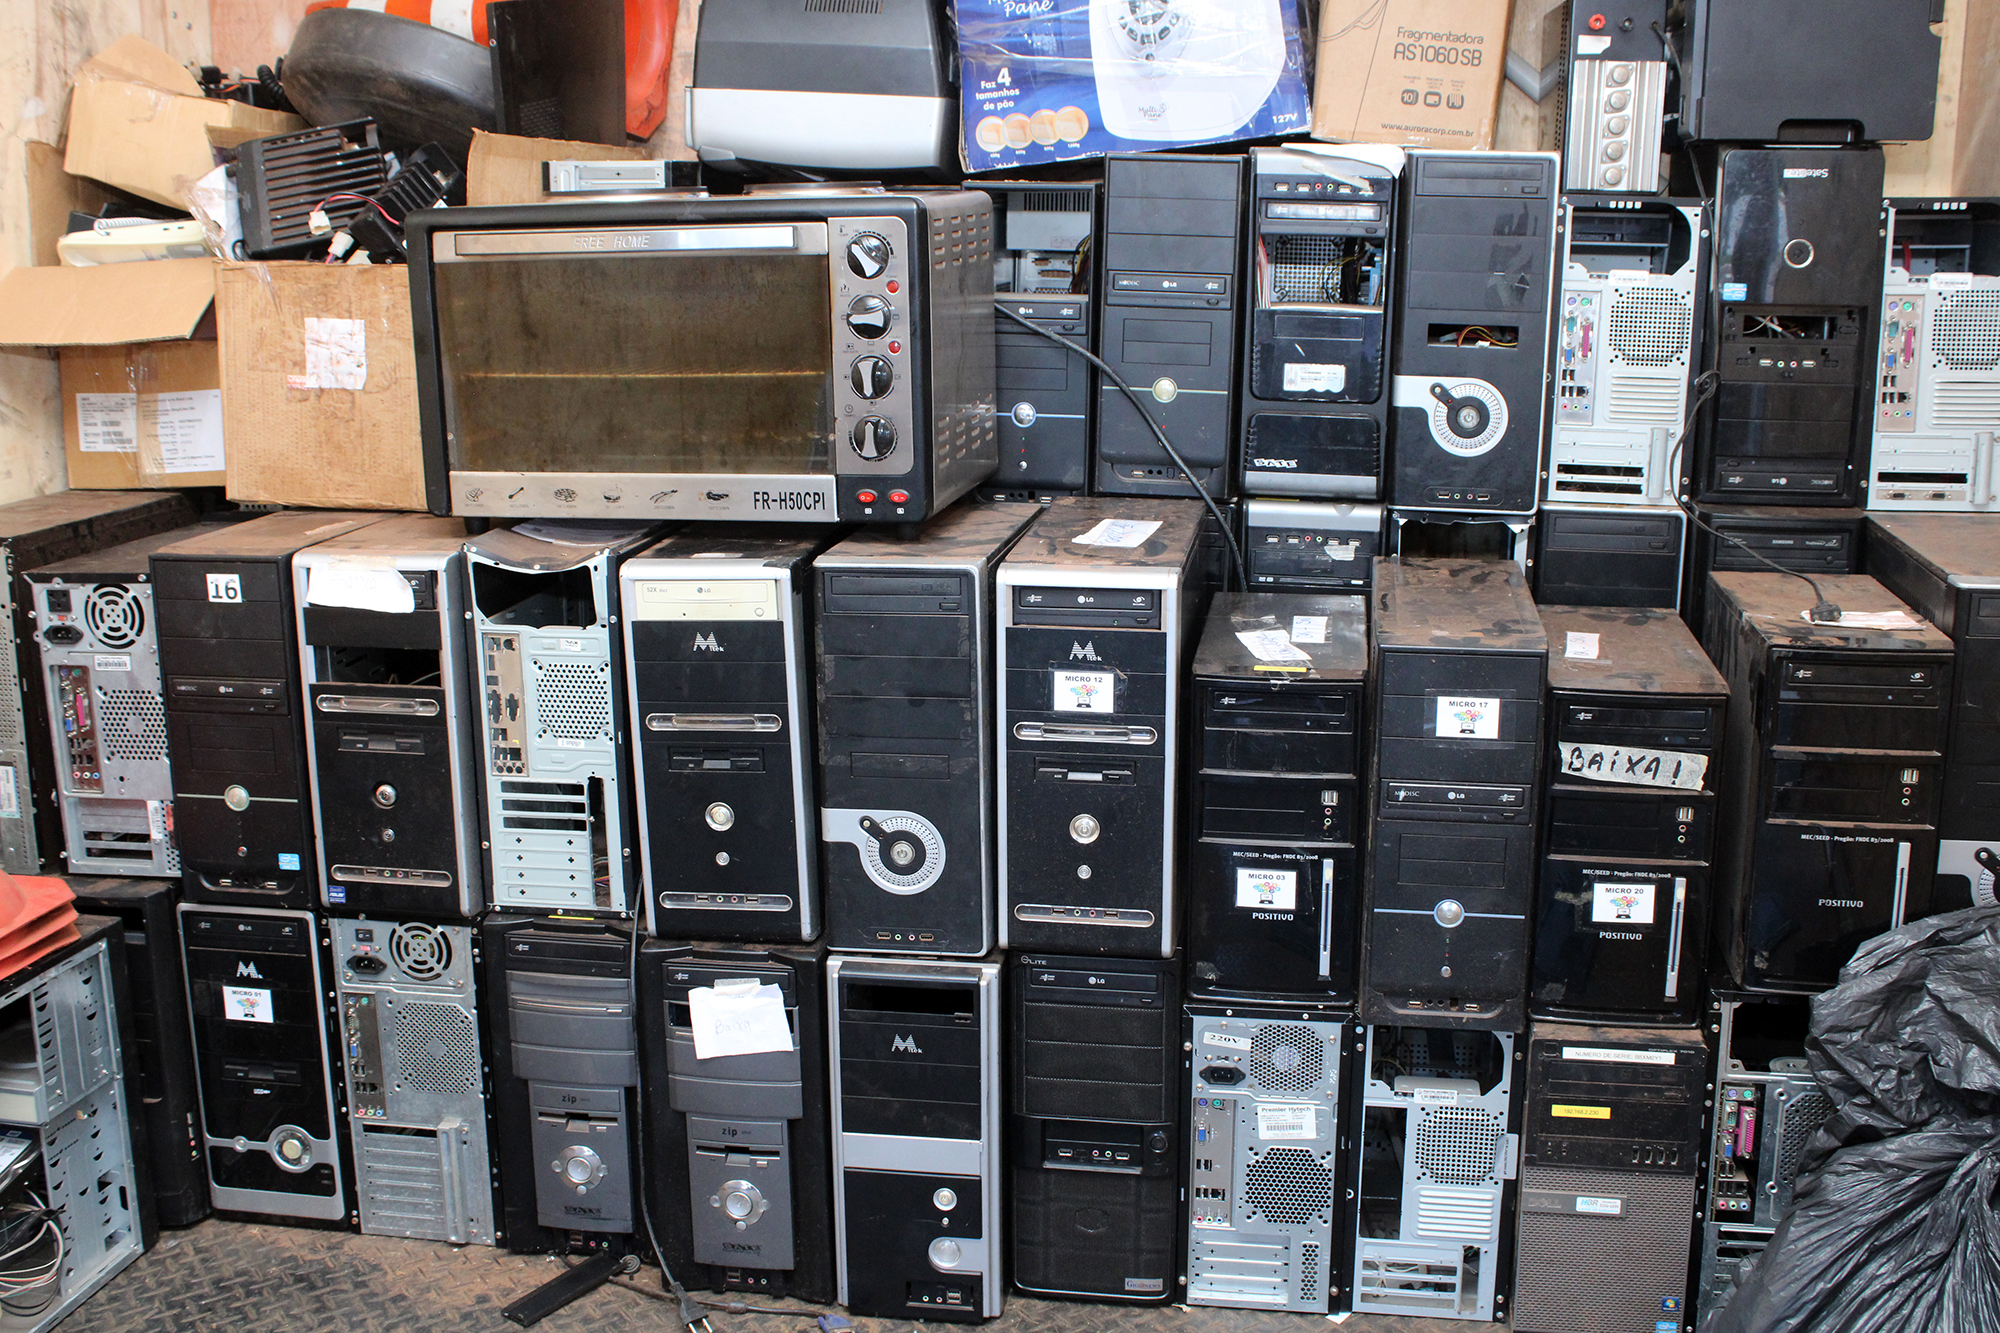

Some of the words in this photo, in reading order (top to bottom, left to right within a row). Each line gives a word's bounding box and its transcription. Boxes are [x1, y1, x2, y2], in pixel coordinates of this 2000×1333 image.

[1396, 26, 1484, 44] Fragmentadora
[981, 80, 996, 89] Faz
[997, 67, 1012, 86] 4
[976, 88, 1020, 100] tamanhos
[983, 101, 995, 110] de
[997, 100, 1014, 111] pão
[1272, 113, 1298, 124] 127V
[1381, 123, 1475, 137] www.auroracorp.com.br
[1790, 168, 1829, 179] Satellite
[573, 236, 605, 249] FREE
[613, 234, 650, 248] HOME
[1253, 458, 1297, 469] SATE
[753, 491, 826, 511] FR-H50CPI
[210, 578, 238, 600] 16
[1065, 675, 1091, 683] MICRO
[1818, 899, 1864, 908] POSITIVO
[1252, 912, 1294, 921] POSITIVO
[1599, 932, 1643, 941] POSITIVO
[1209, 1034, 1241, 1044] 220V
[561, 1094, 577, 1103] zip
[722, 1126, 738, 1137] zip
